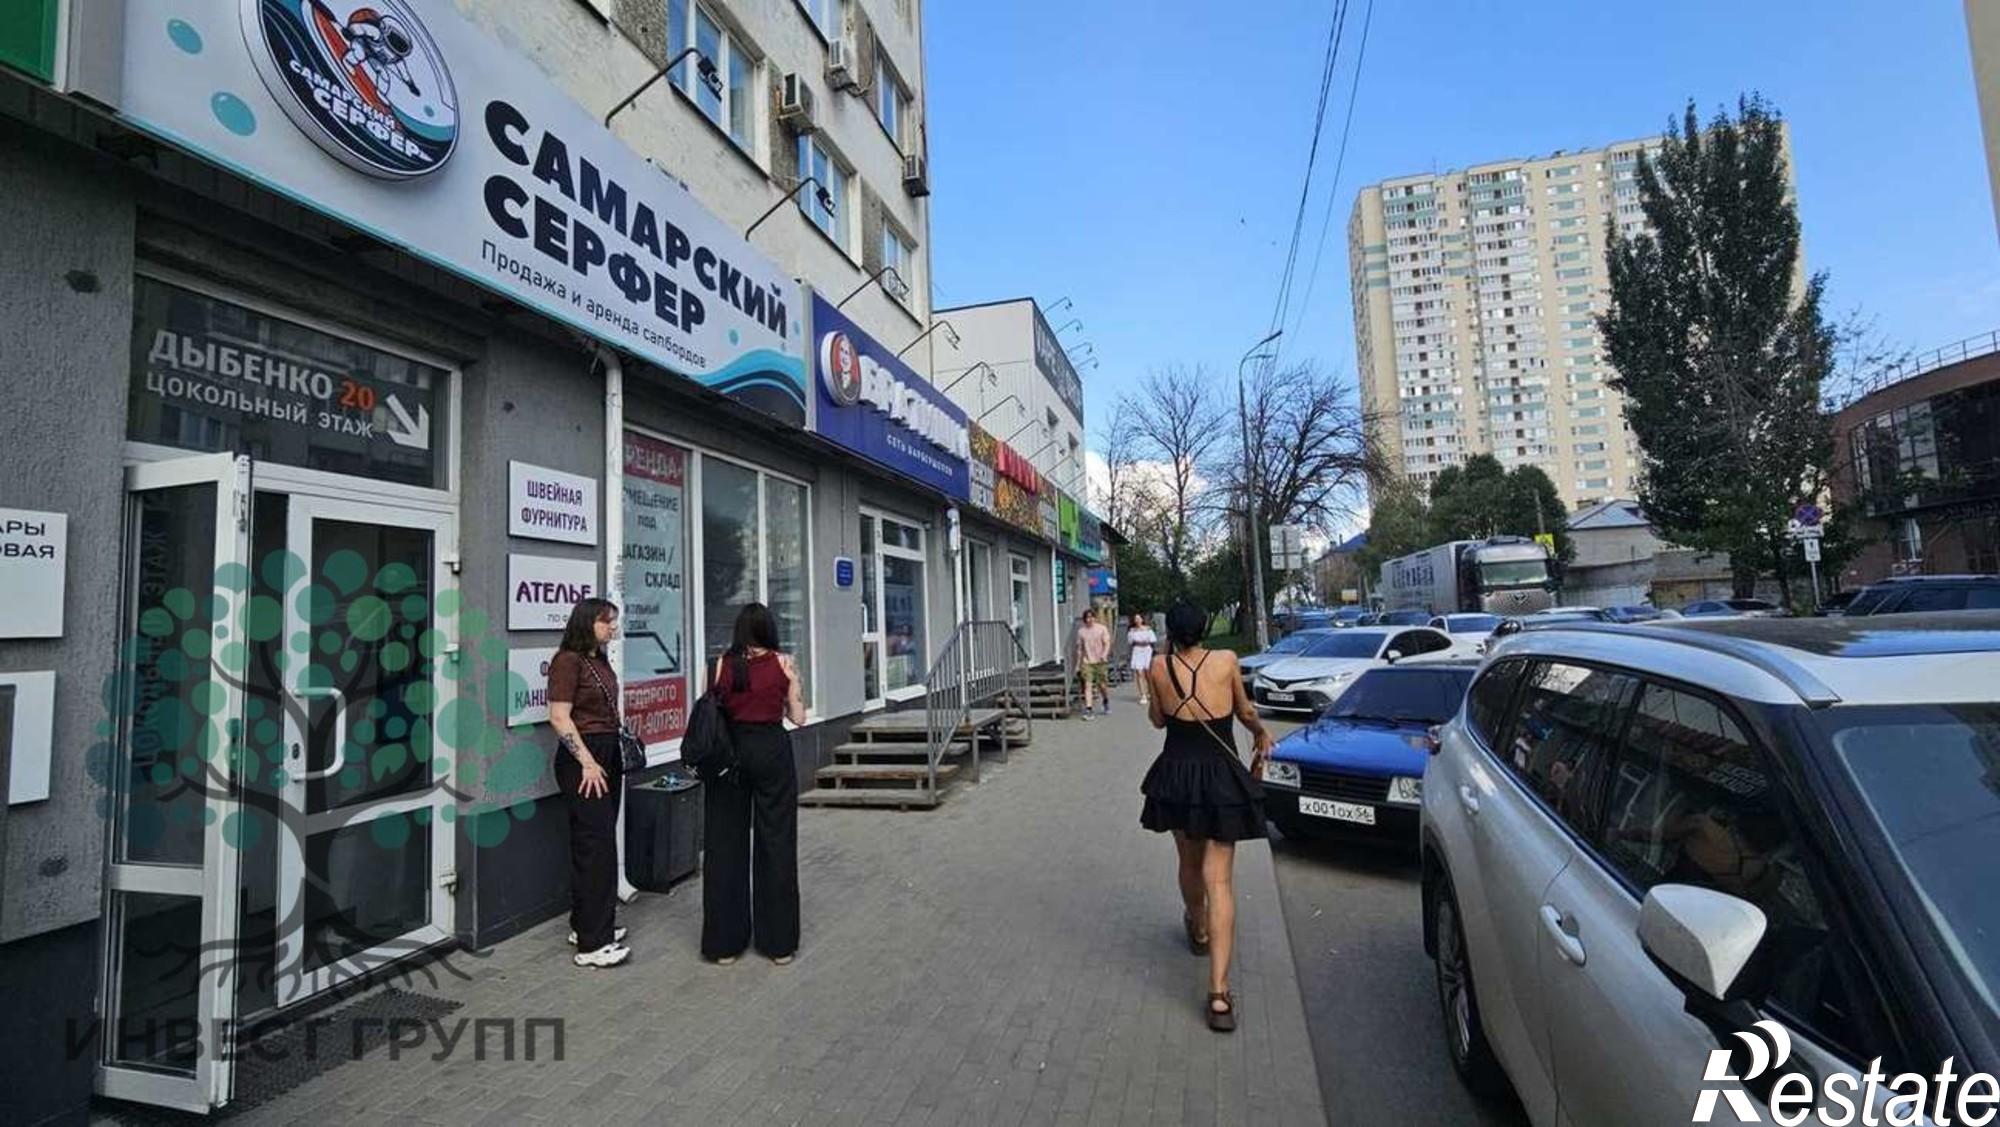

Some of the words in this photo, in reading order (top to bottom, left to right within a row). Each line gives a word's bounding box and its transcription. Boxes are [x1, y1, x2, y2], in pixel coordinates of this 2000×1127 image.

[289, 59, 396, 131] САМАРСКИЙ
[313, 86, 420, 158] СЕРФЕР
[484, 100, 787, 339] САМАРСКИЙ
[484, 174, 706, 334] СЕРФЕР
[482, 239, 567, 298] Продажа
[572, 291, 582, 307] и
[587, 299, 639, 335] аренда
[643, 325, 707, 369] сапбордов
[148, 329, 333, 400] ДЫБЕНКО
[340, 378, 377, 411] 20
[147, 371, 307, 425] ЦОКОЛЬНЫЙ
[318, 411, 374, 438] ЭТАЖ
[624, 444, 678, 479] РЕНДА
[527, 480, 583, 506] ШВЕЙНАЯ
[622, 486, 679, 512] МЕЩЕНИЕ
[0, 520, 45, 537] РЫ
[521, 506, 587, 532] ФУРНИТУРА
[0, 543, 55, 560] ВАЯ
[622, 544, 666, 563] АГАЗИН
[516, 580, 592, 604] АТЕЛЬЕ
[645, 571, 681, 590] СКЛАД
[515, 688, 551, 710] КАНЦ
